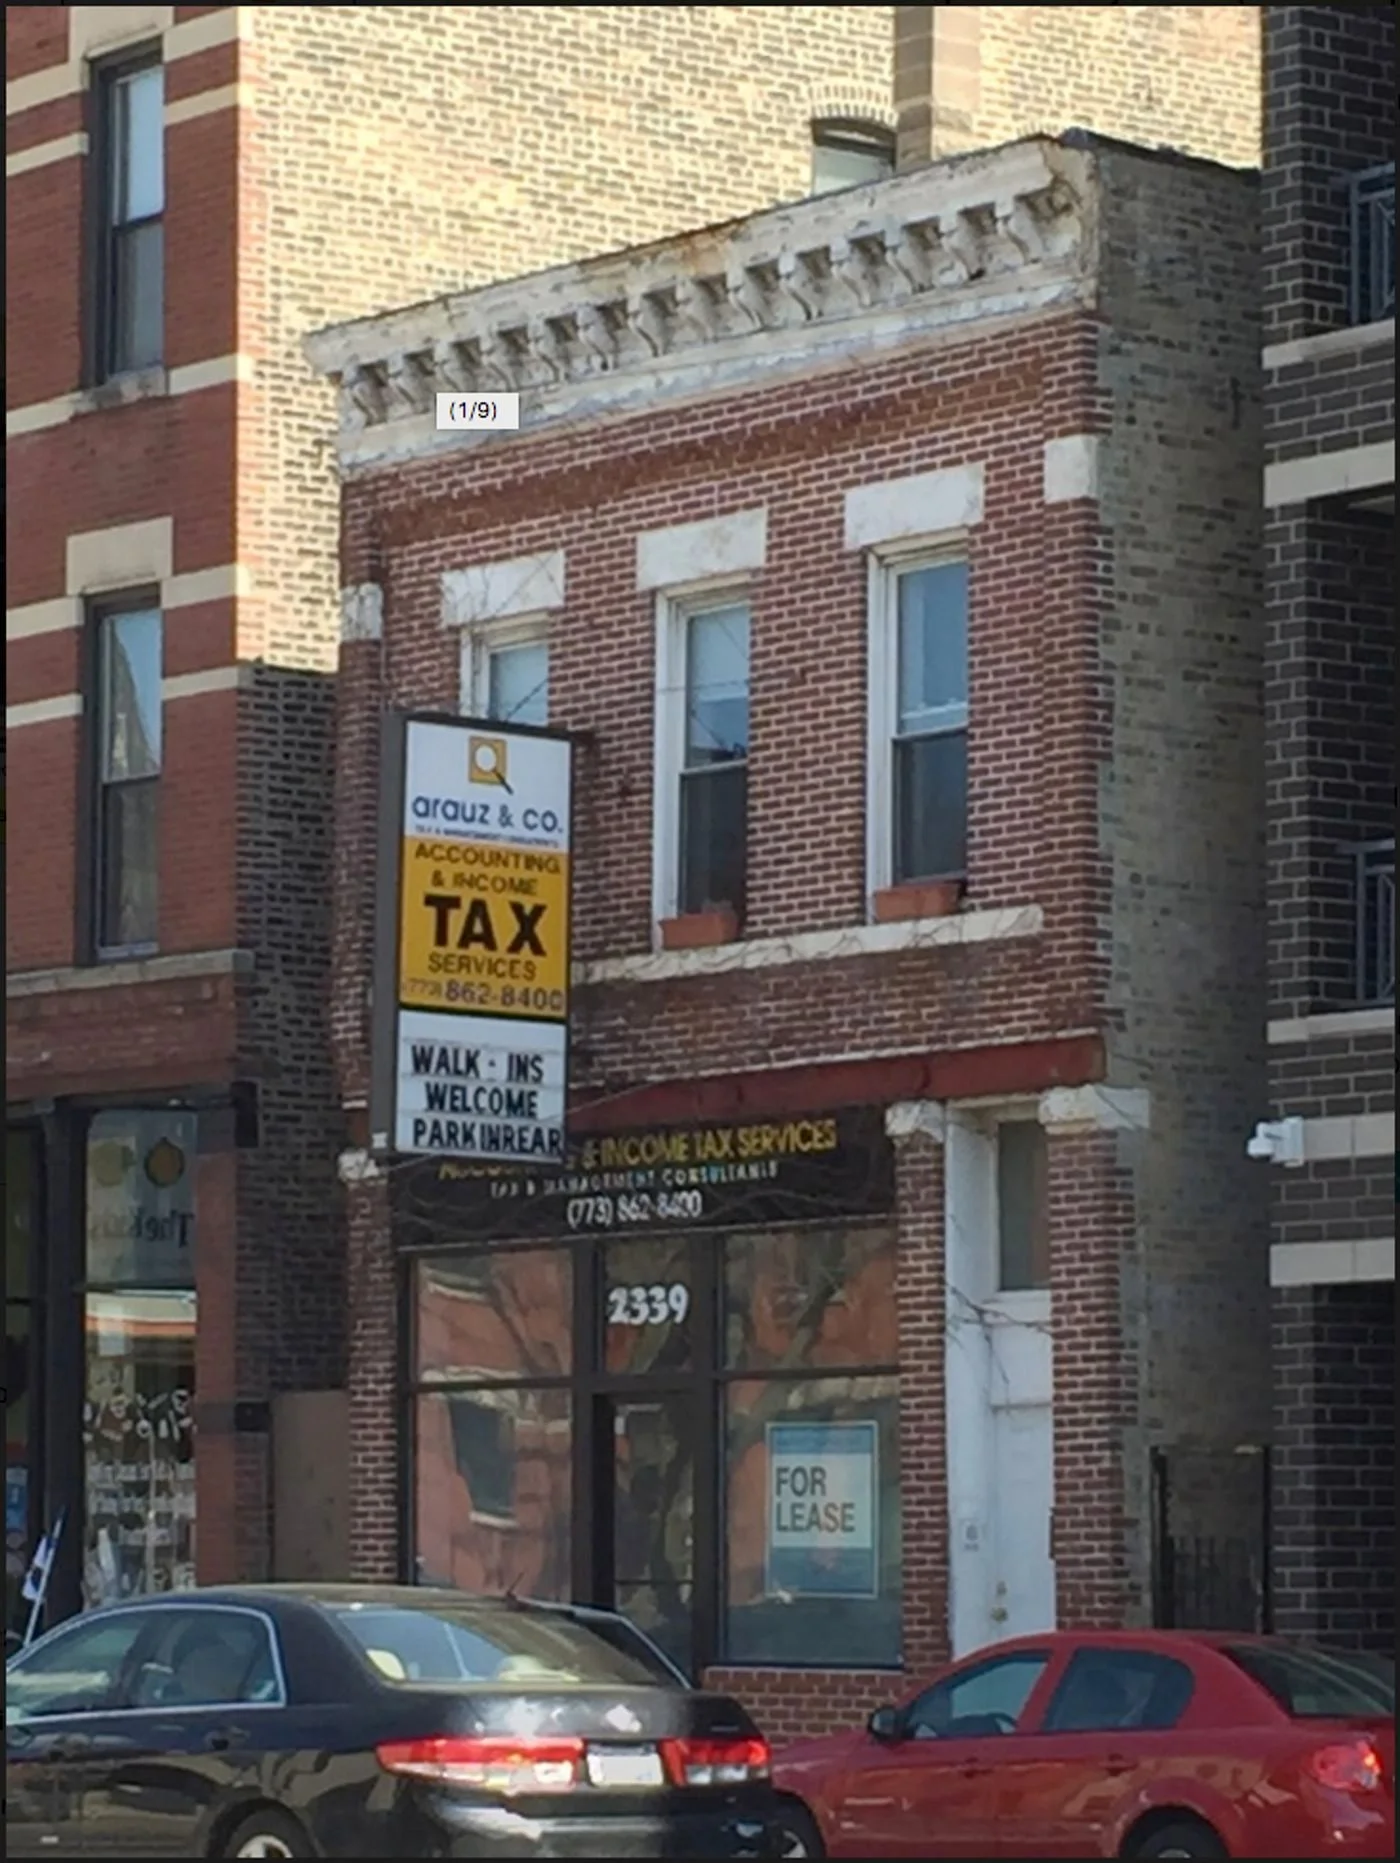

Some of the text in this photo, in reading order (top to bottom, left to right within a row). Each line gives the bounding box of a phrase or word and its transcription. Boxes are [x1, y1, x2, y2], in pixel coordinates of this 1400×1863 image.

[412, 795, 490, 825] arauz
[499, 804, 514, 828] &
[415, 842, 561, 874] ACCOUNTING
[431, 869, 539, 896] & INCOME
[424, 893, 547, 957] TAX
[428, 952, 537, 981] SERVICES
[411, 1045, 480, 1079] WALK
[507, 1053, 543, 1083] INS
[425, 1081, 539, 1119] WELCOME
[601, 1131, 689, 1167] INCOME
[695, 1128, 735, 1158] TAX
[738, 1118, 836, 1156] SERVICES
[567, 1194, 613, 1229] (773)
[608, 1283, 689, 1326] 2339
[776, 1466, 827, 1497] FOR
[776, 1502, 855, 1533] LEASE
